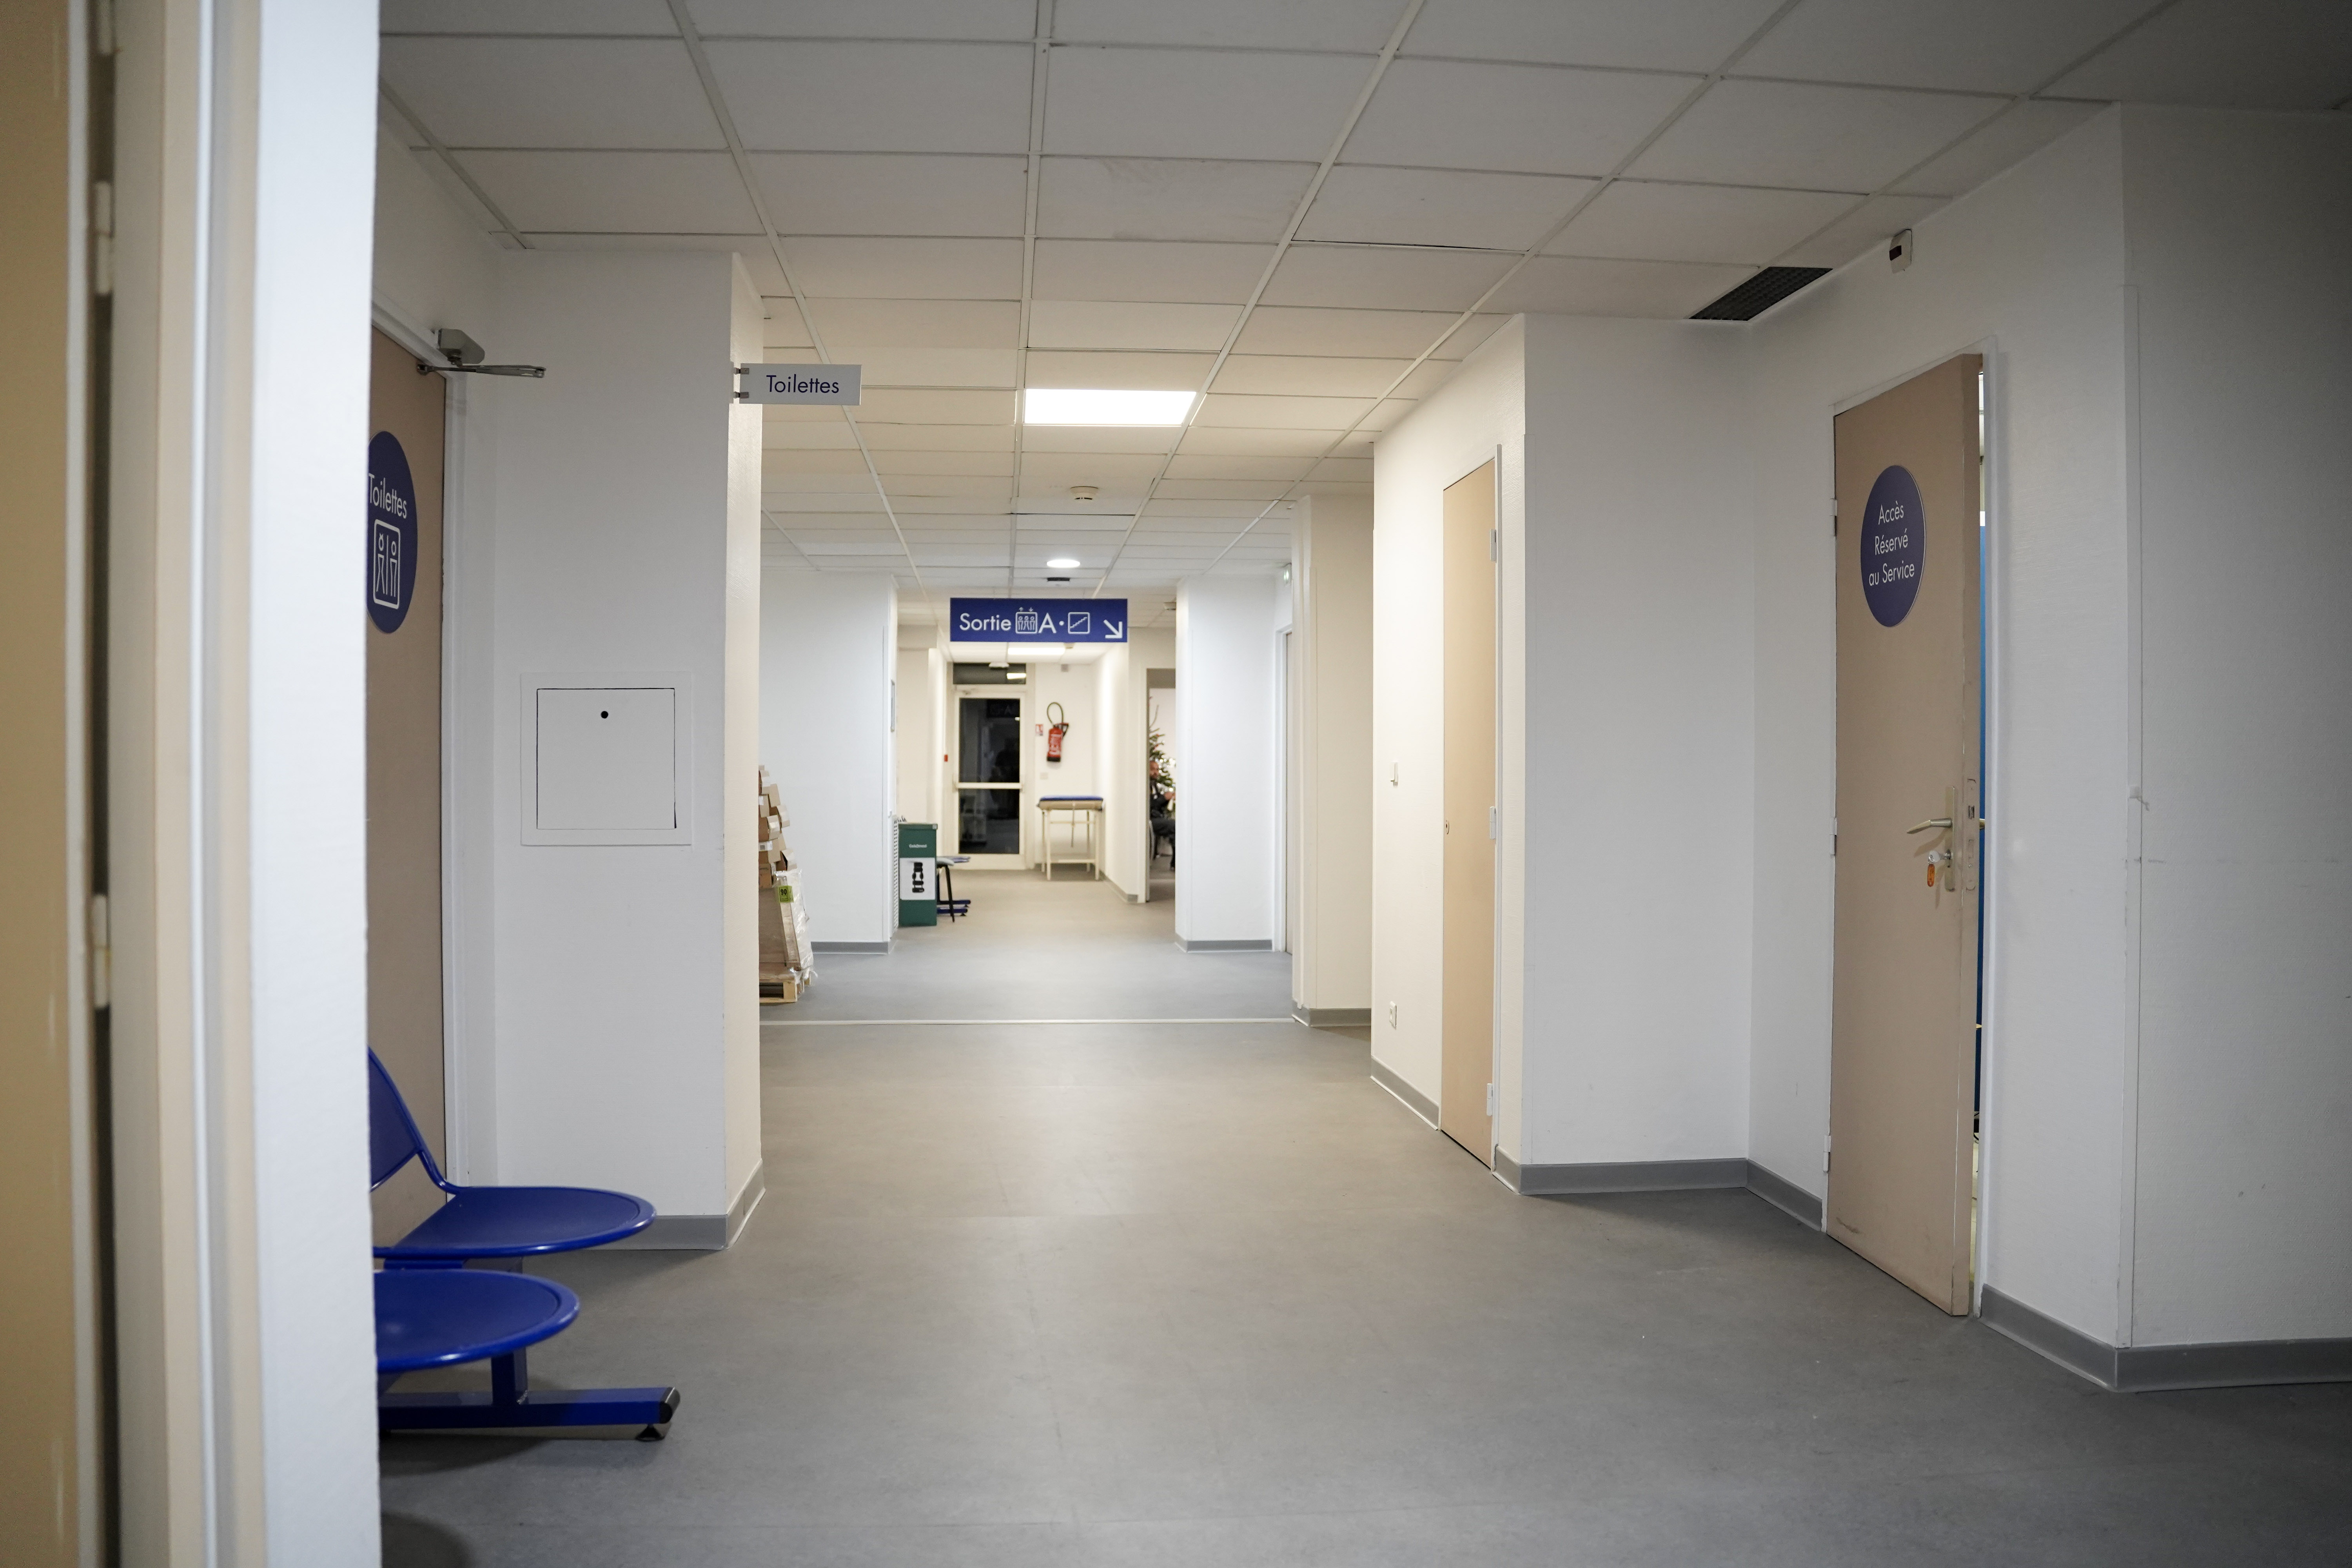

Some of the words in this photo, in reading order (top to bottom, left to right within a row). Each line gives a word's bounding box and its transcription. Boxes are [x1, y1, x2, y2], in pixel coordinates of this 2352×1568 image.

[766, 374, 839, 394] Toilettes
[368, 473, 407, 519] Toilettes
[1878, 500, 1904, 525] Accès
[1875, 528, 1909, 555] Réservé
[1869, 572, 1880, 586] au
[1882, 560, 1915, 584] Service
[959, 613, 1011, 631] Sortie
[1038, 613, 1057, 633] A
